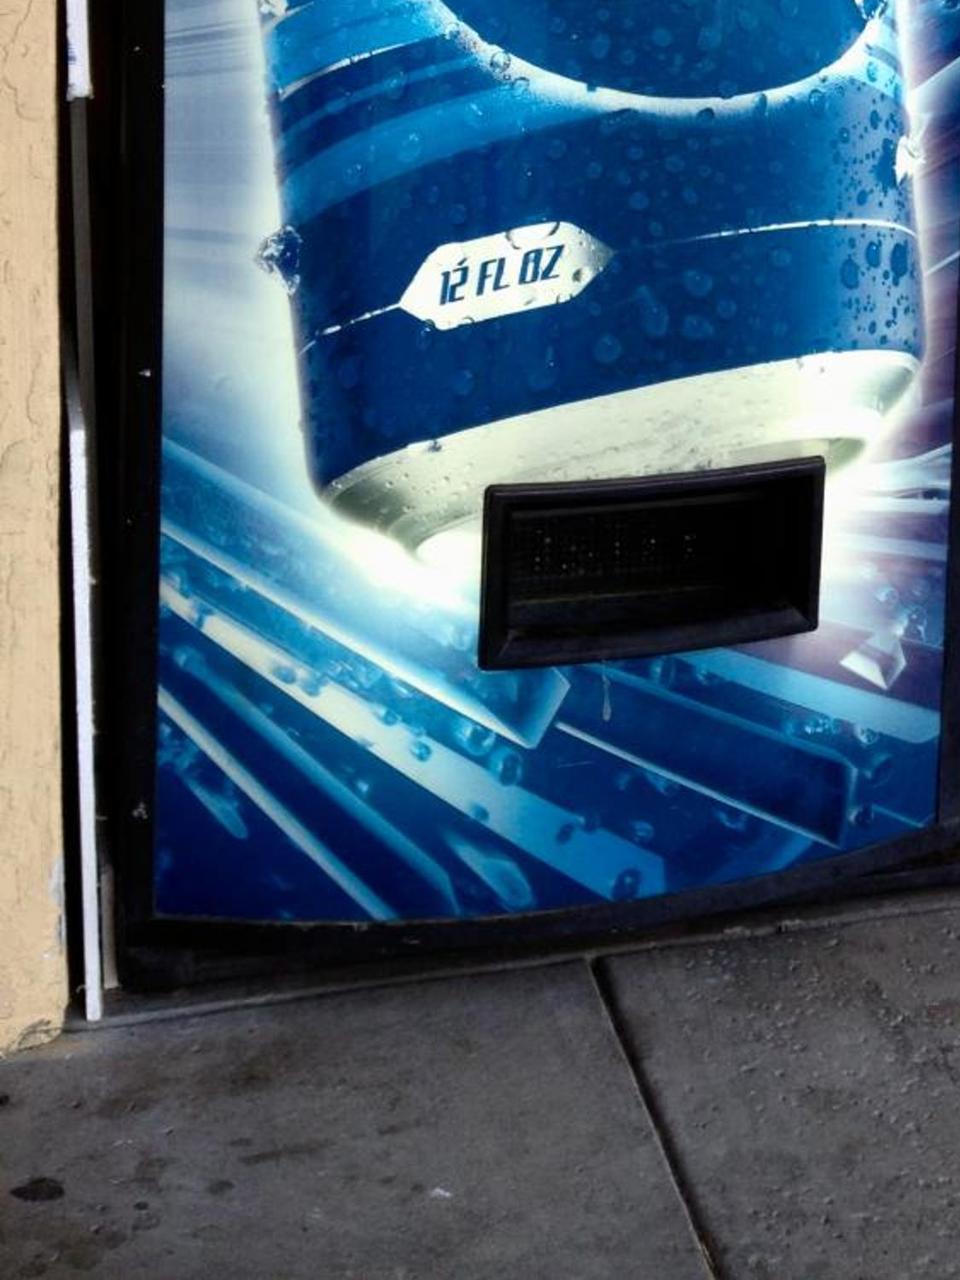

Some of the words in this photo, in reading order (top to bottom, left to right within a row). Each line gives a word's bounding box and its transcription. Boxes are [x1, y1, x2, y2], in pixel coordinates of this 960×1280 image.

[439, 263, 471, 306] 12
[476, 257, 511, 297] FL
[518, 245, 566, 286] OZ
